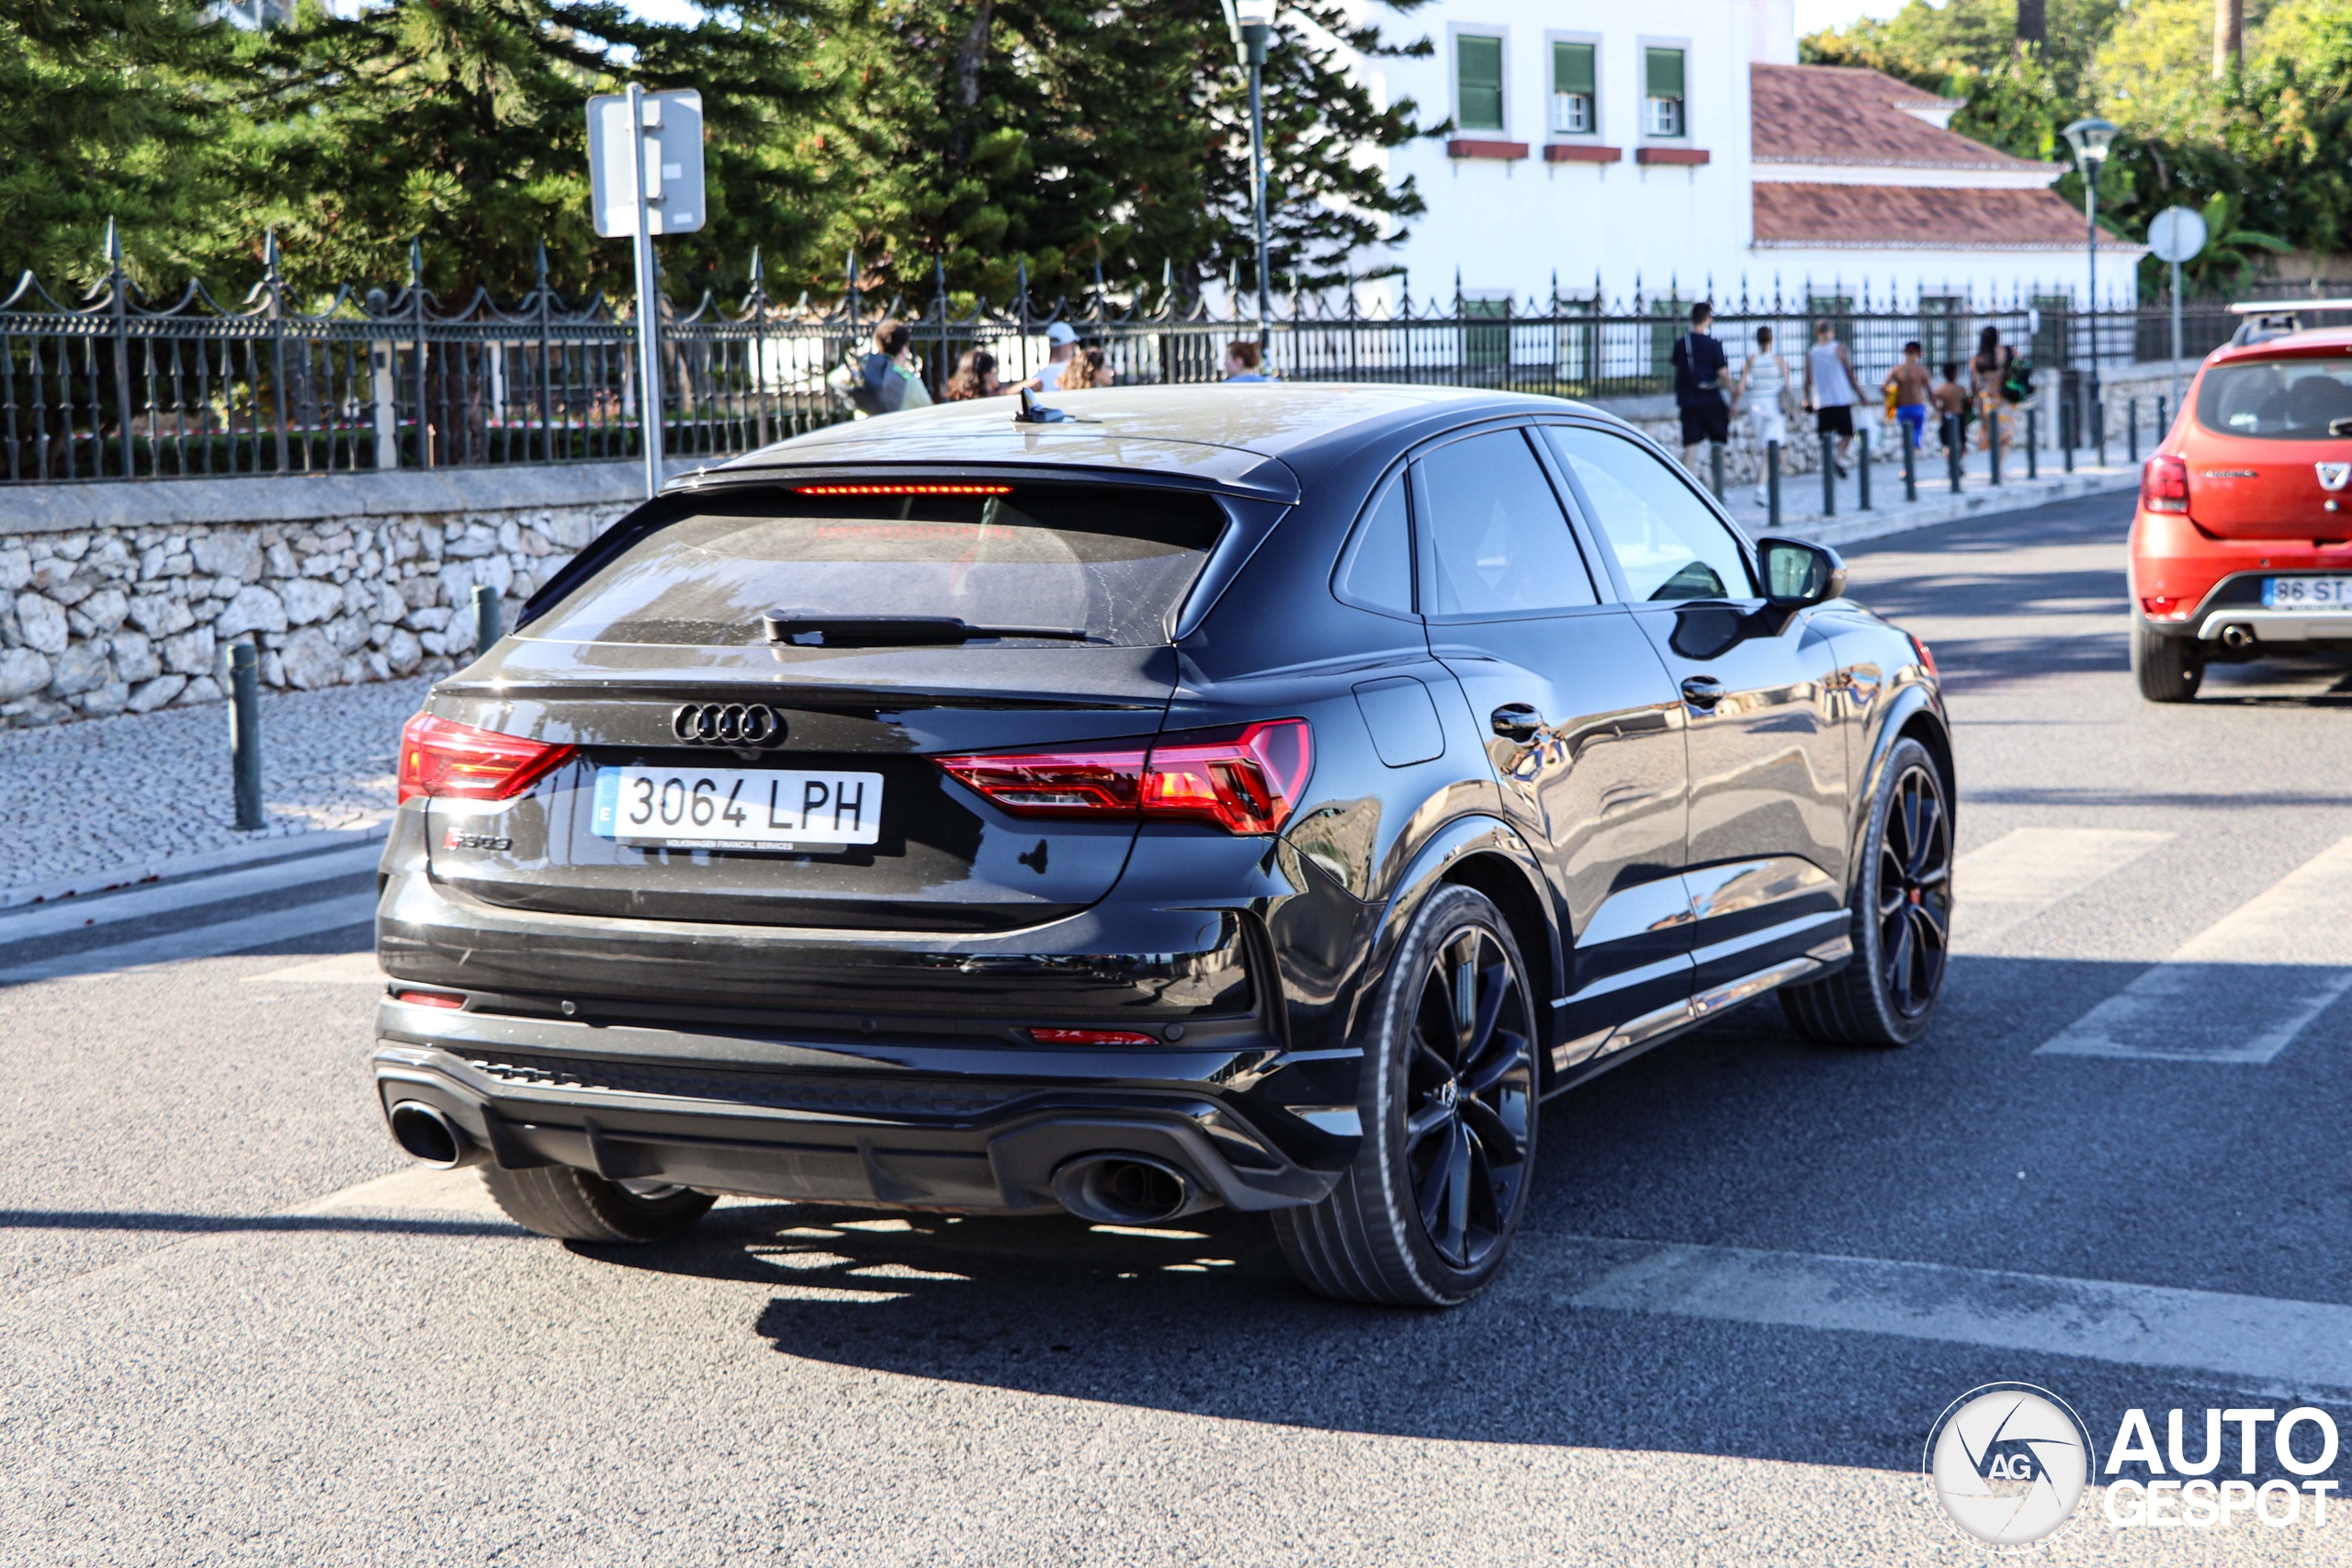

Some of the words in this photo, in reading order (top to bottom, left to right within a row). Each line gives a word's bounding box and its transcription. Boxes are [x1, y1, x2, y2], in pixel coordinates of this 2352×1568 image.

[2313, 580, 2344, 602] ST
[629, 776, 747, 828] 3064
[768, 779, 865, 832] LPH
[599, 807, 613, 821] E
[665, 839, 717, 848] VOLKSWAGEN
[717, 840, 755, 850] FINANCIAL
[756, 841, 794, 851] SERVICES
